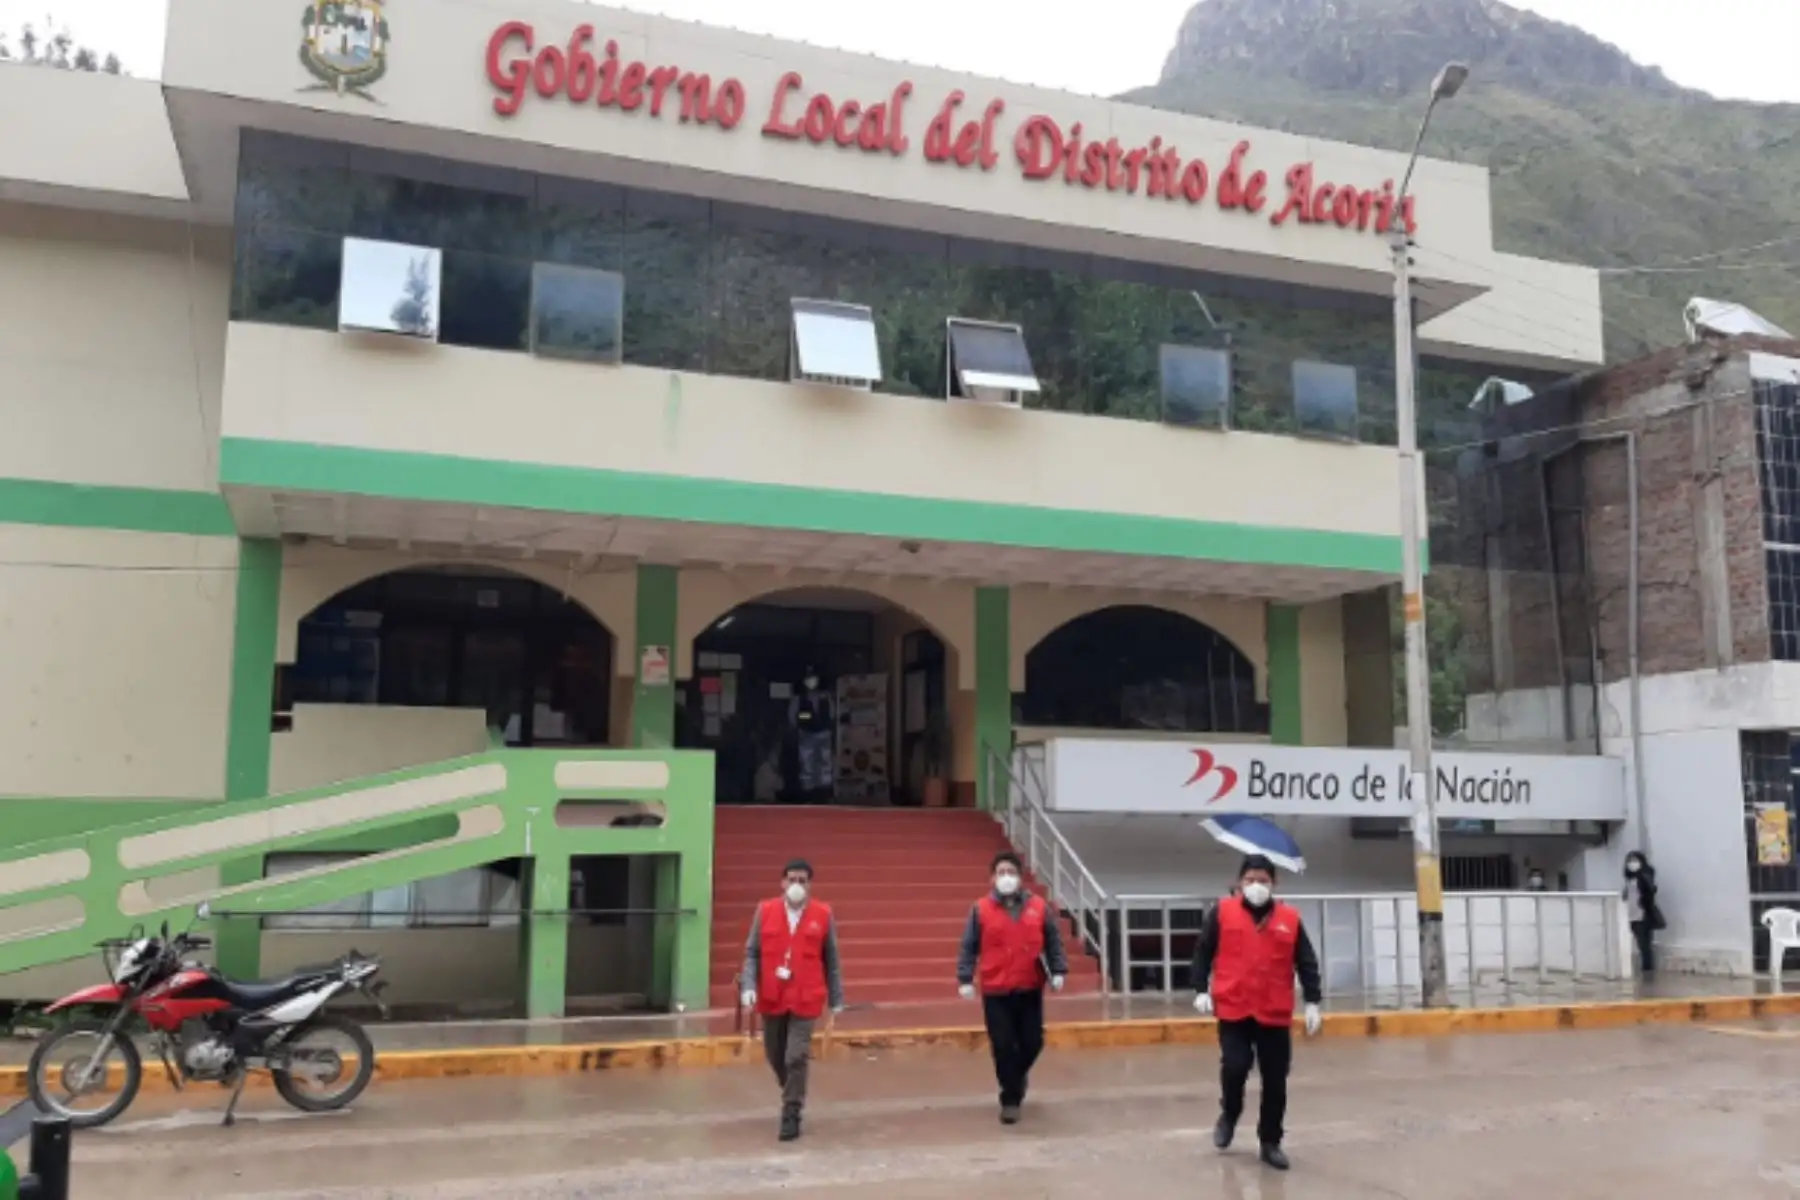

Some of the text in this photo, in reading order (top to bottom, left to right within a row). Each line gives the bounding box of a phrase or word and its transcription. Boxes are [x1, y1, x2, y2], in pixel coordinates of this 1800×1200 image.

[486, 20, 746, 129] Gobierno
[761, 71, 913, 154] Local
[925, 90, 1004, 170] del
[1015, 115, 1209, 204] Distrito
[1217, 140, 1267, 212] de
[1247, 759, 1340, 801] Banco
[1351, 764, 1387, 802] de
[1435, 765, 1532, 805] Nación
